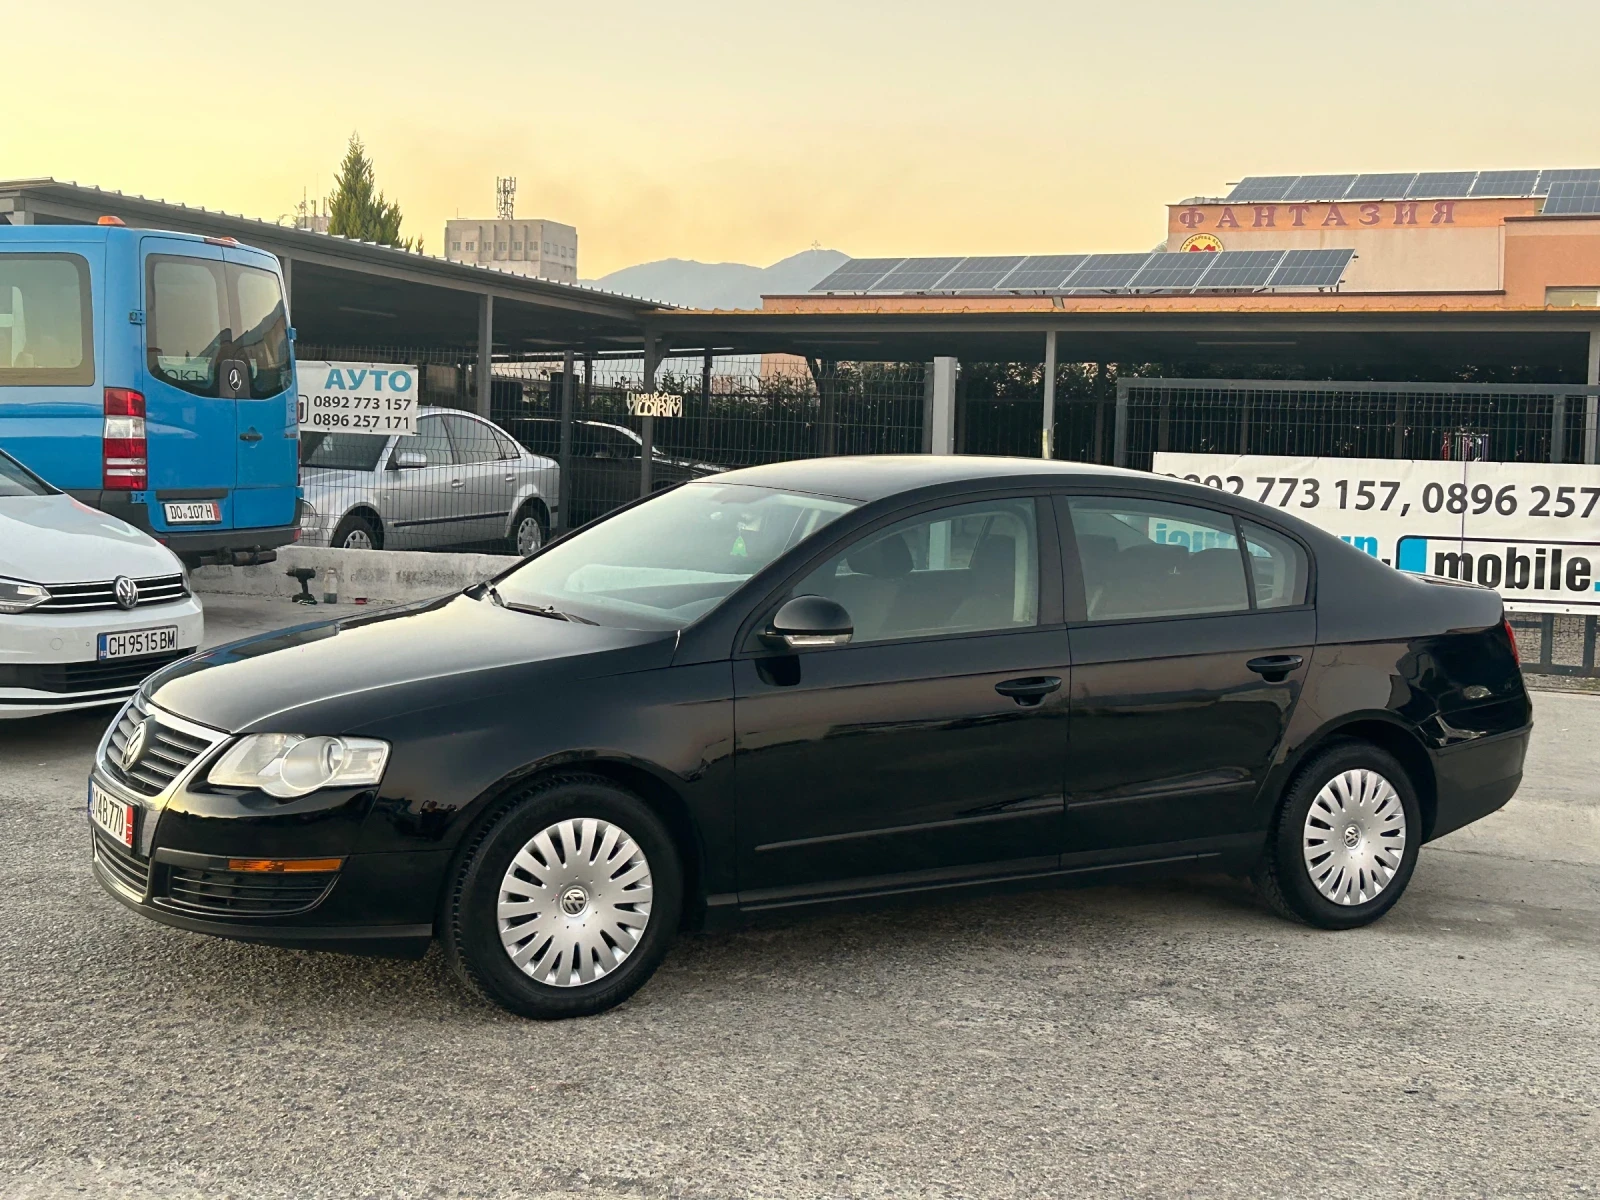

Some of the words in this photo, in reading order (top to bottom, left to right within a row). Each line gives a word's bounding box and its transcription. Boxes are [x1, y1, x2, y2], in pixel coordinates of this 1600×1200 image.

[1178, 201, 1455, 228] ФАНТАЗИЯ
[324, 368, 412, 392] АУТО
[313, 395, 350, 408] 0892
[354, 397, 380, 410] 773
[385, 398, 412, 410] 157
[313, 413, 350, 426] 0896
[353, 415, 380, 428] 257
[385, 416, 409, 429] 171
[1256, 477, 1320, 508] 773
[1334, 480, 1411, 517] 157,
[1422, 482, 1518, 516] 0896
[1528, 485, 1600, 519] 257
[109, 636, 126, 655] CH
[129, 632, 158, 653] 9515
[160, 630, 175, 649] BM
